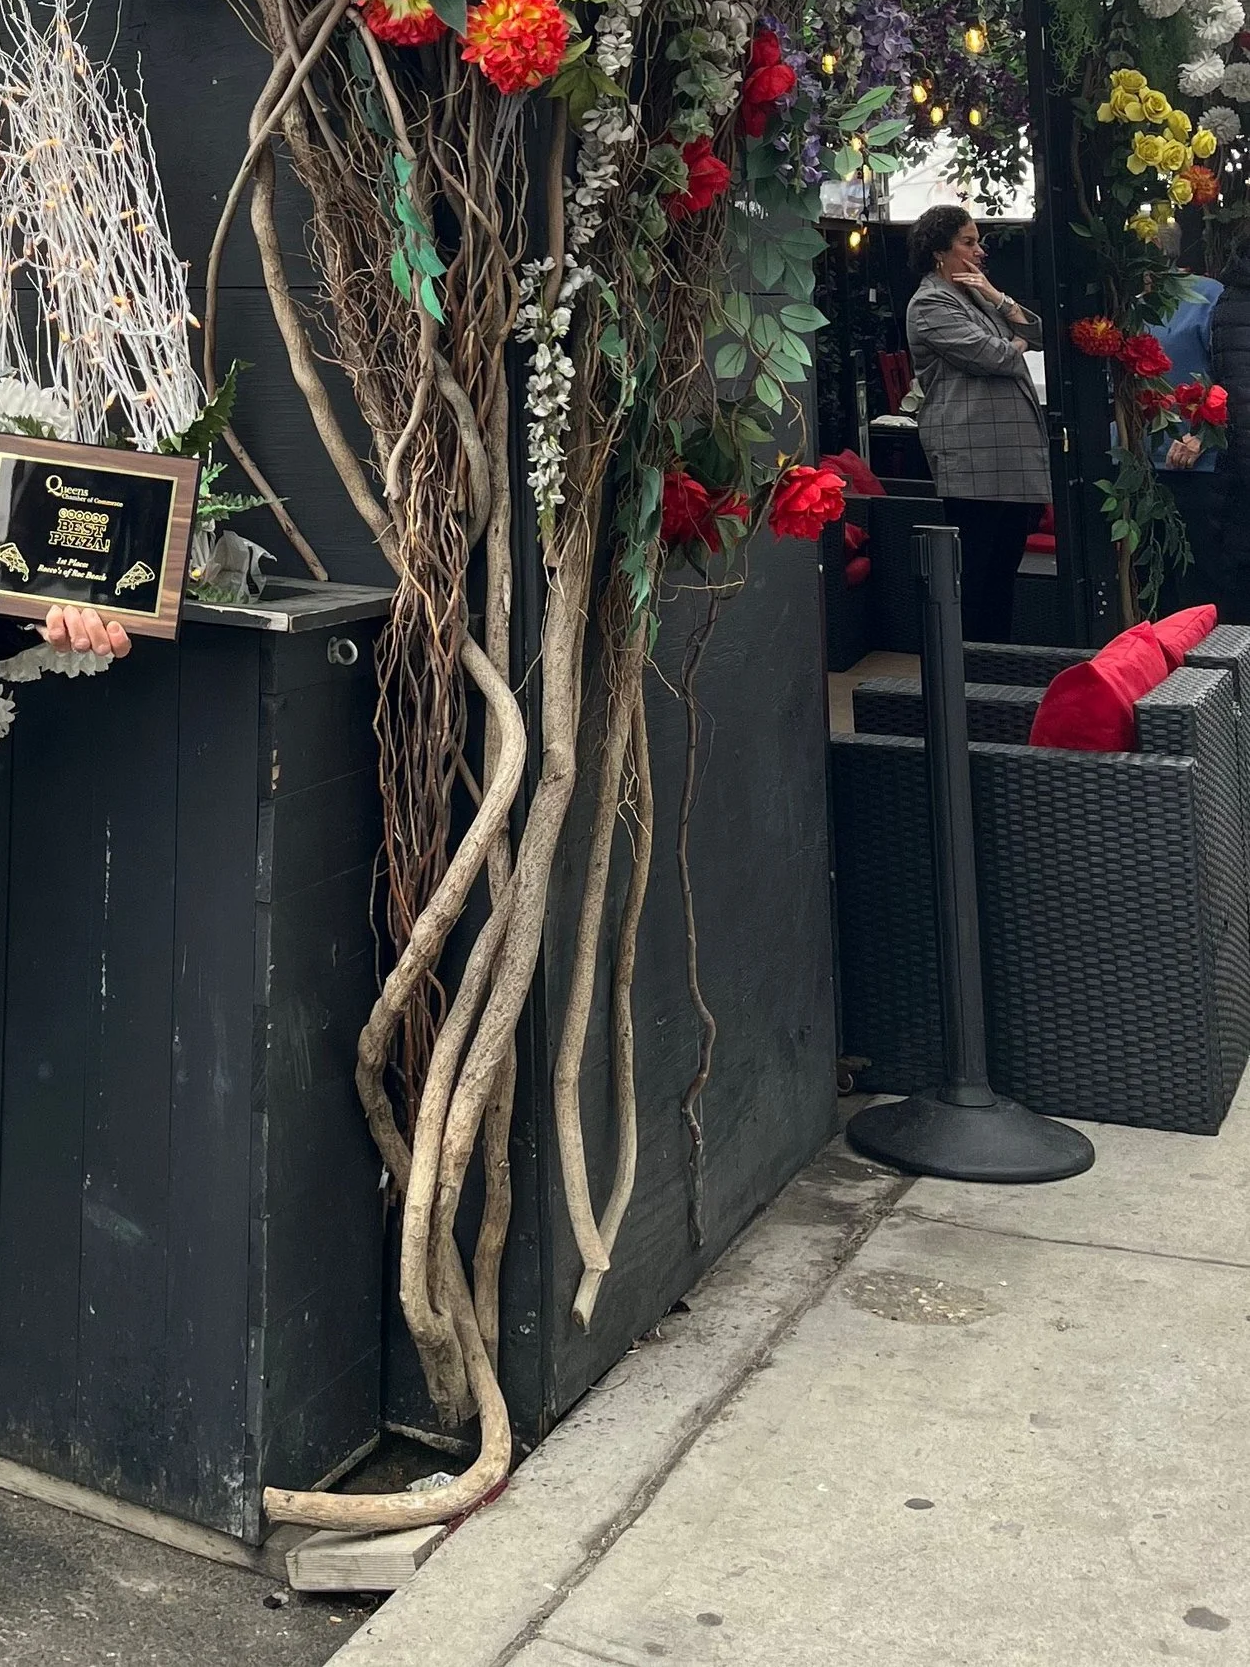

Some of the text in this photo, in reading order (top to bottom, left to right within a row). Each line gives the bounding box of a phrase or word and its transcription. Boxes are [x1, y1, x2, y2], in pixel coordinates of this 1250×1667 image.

[45, 475, 89, 497] Queens
[57, 519, 107, 537] BEST
[48, 531, 111, 553] PIZZA!
